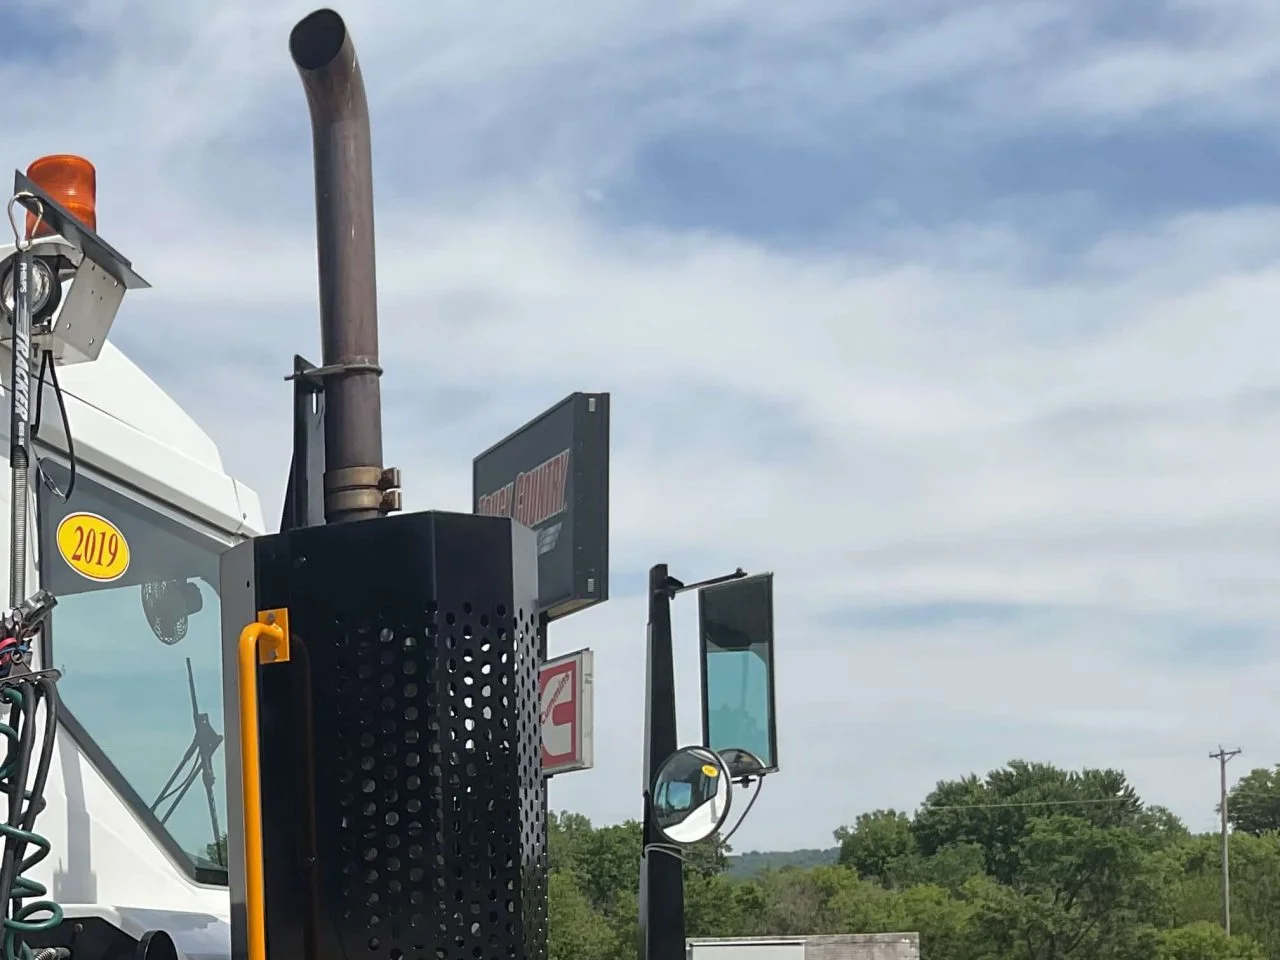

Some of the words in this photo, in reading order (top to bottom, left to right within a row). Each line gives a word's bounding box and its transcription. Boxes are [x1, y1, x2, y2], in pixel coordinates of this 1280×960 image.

[15, 331, 30, 422] TRACKER
[514, 448, 570, 528] COUNTRY
[71, 526, 119, 567] 2019
[540, 672, 570, 726] Cummins
